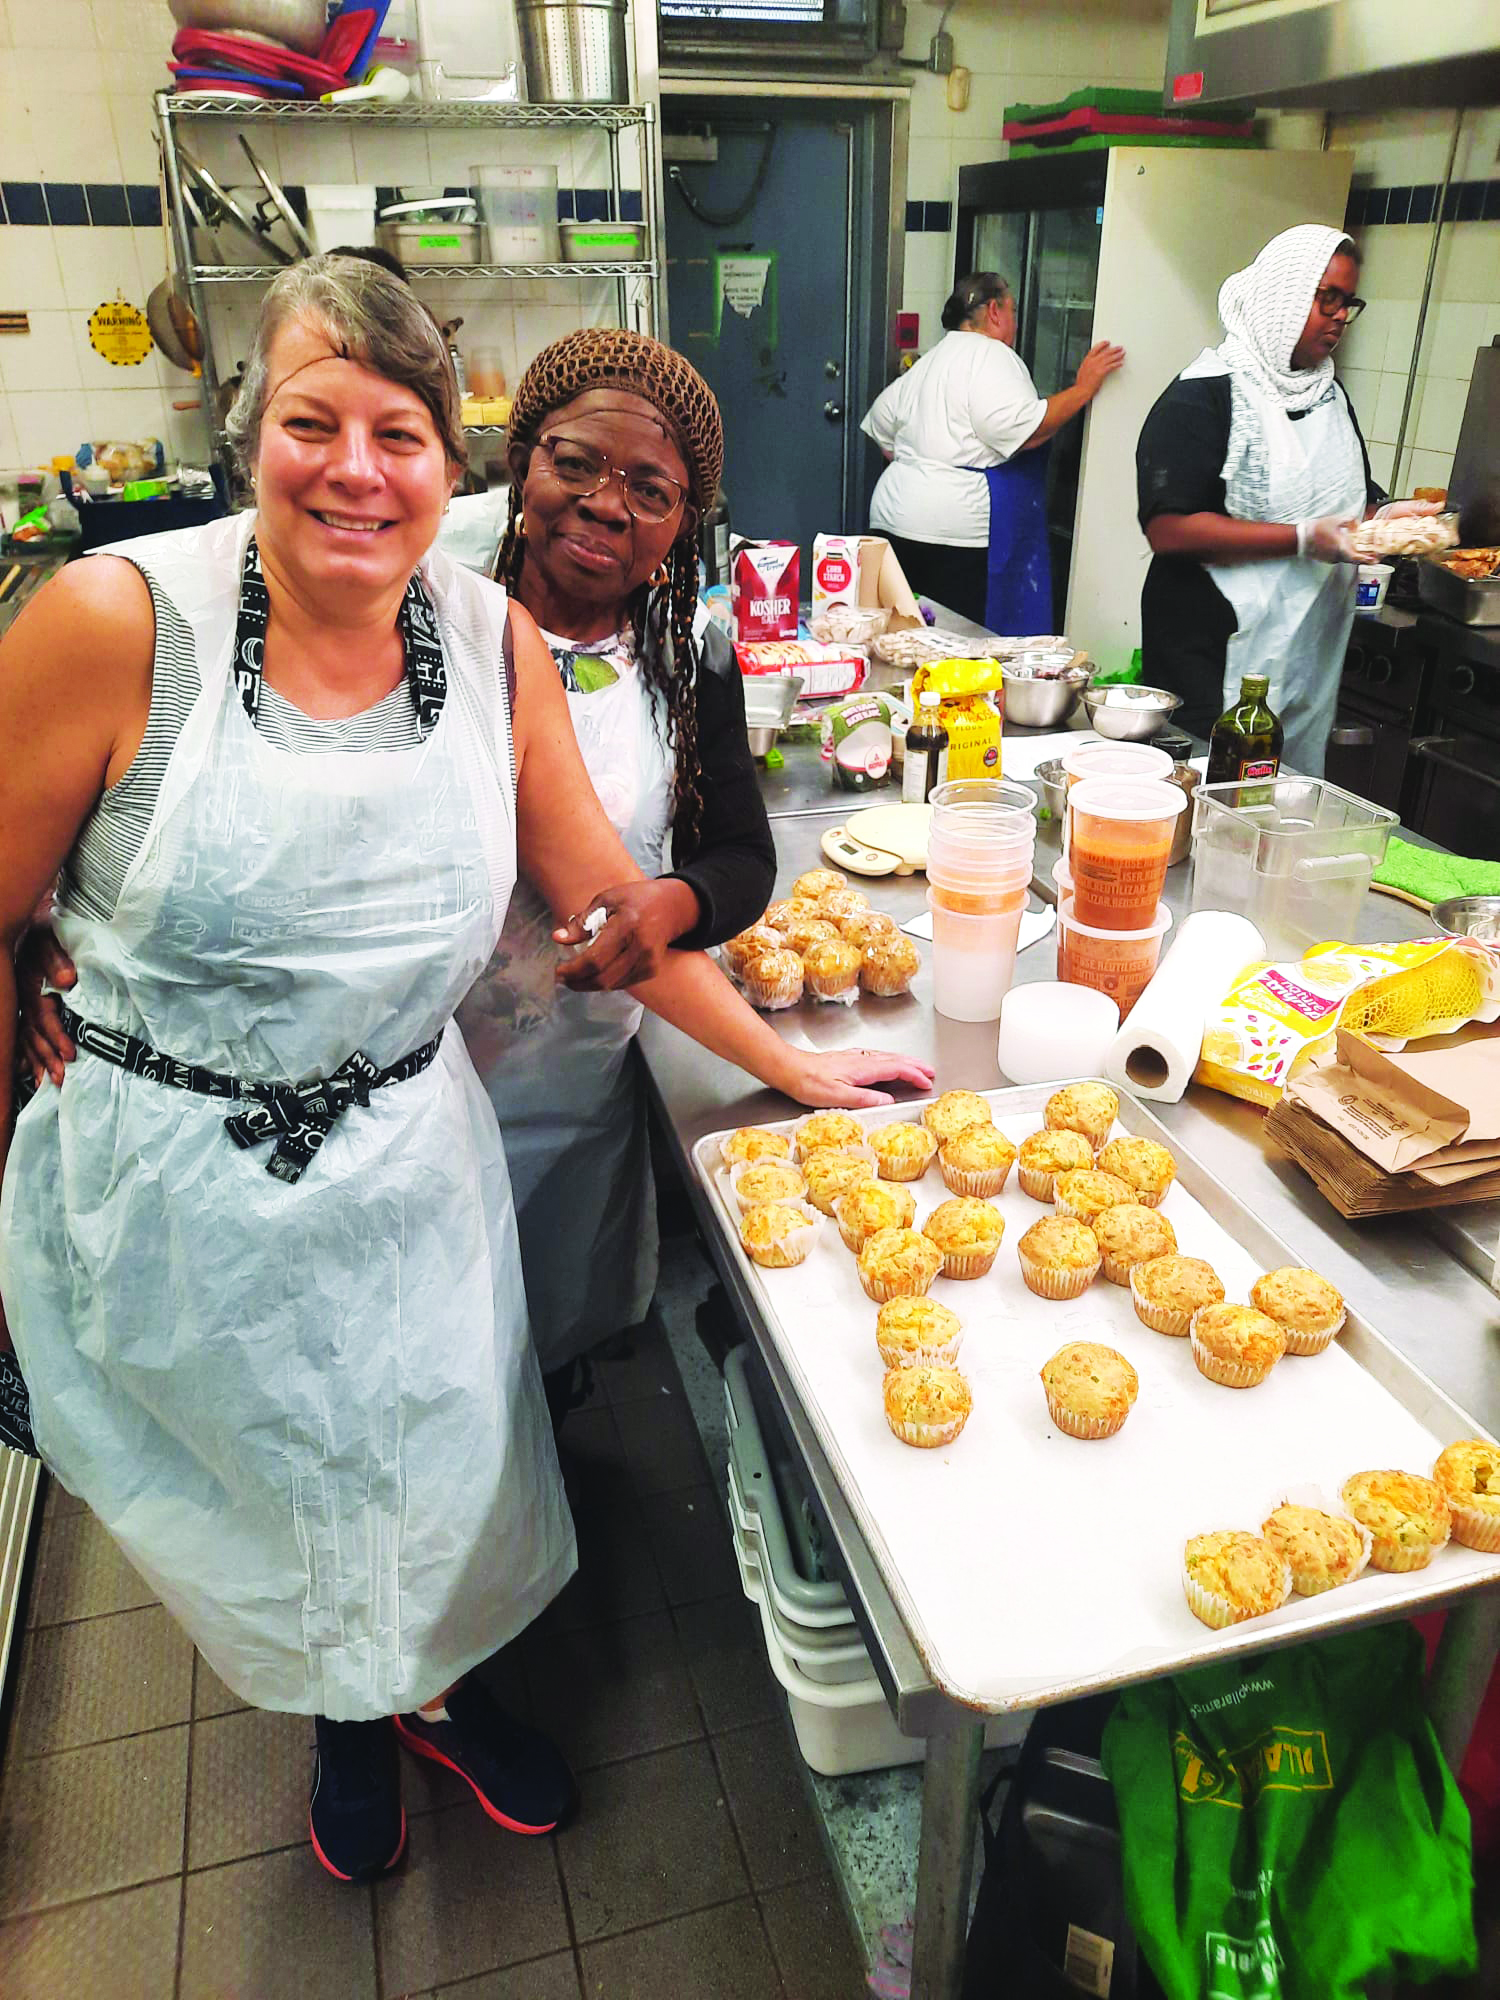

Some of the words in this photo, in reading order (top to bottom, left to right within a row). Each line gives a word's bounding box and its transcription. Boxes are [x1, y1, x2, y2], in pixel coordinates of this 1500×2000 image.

[98, 317, 142, 326] WARNING
[750, 598, 791, 617] KOSHER
[761, 614, 780, 625] SALT
[950, 737, 993, 751] RIGINAL
